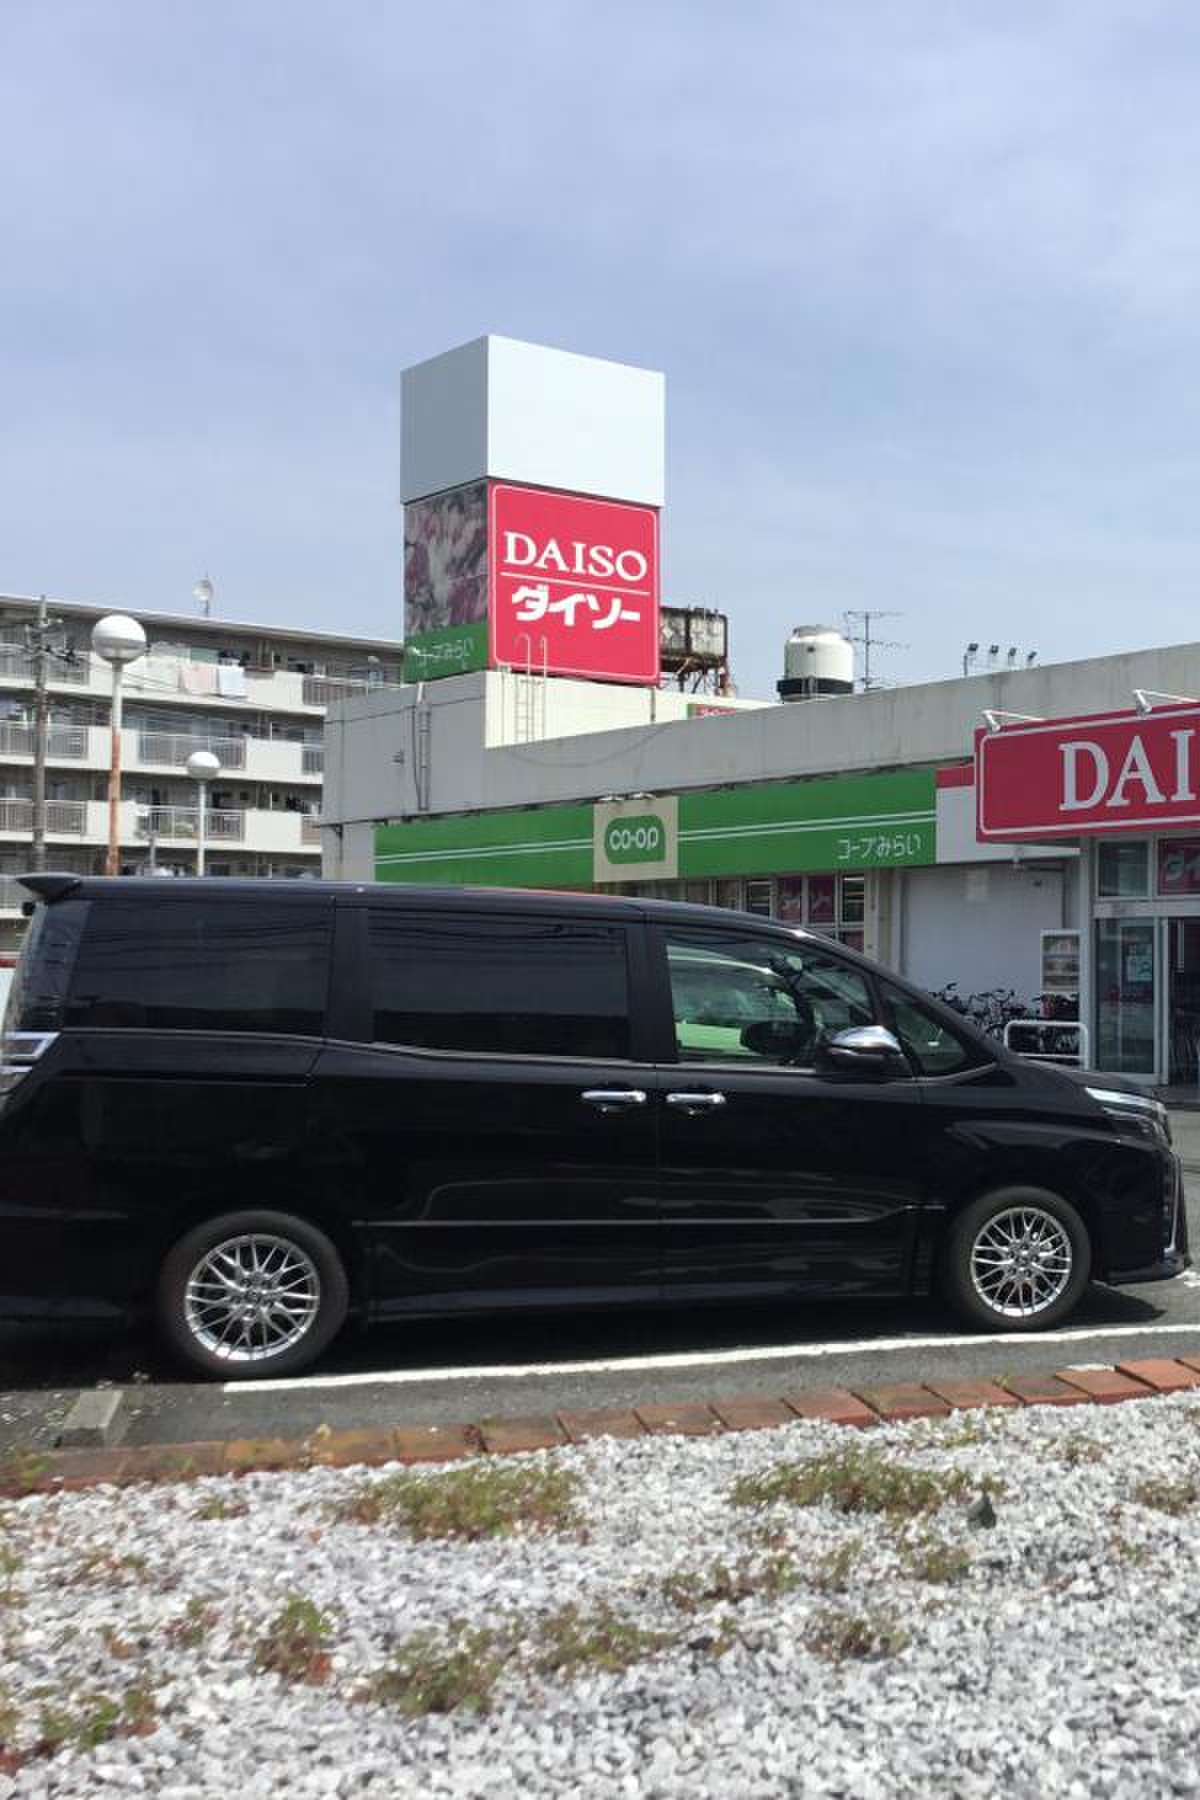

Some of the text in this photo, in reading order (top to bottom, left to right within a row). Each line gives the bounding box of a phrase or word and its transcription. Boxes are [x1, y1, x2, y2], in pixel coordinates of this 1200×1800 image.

[503, 531, 648, 582] DAISO
[511, 584, 641, 630] ダイソー
[837, 829, 922, 860] コープみらい
